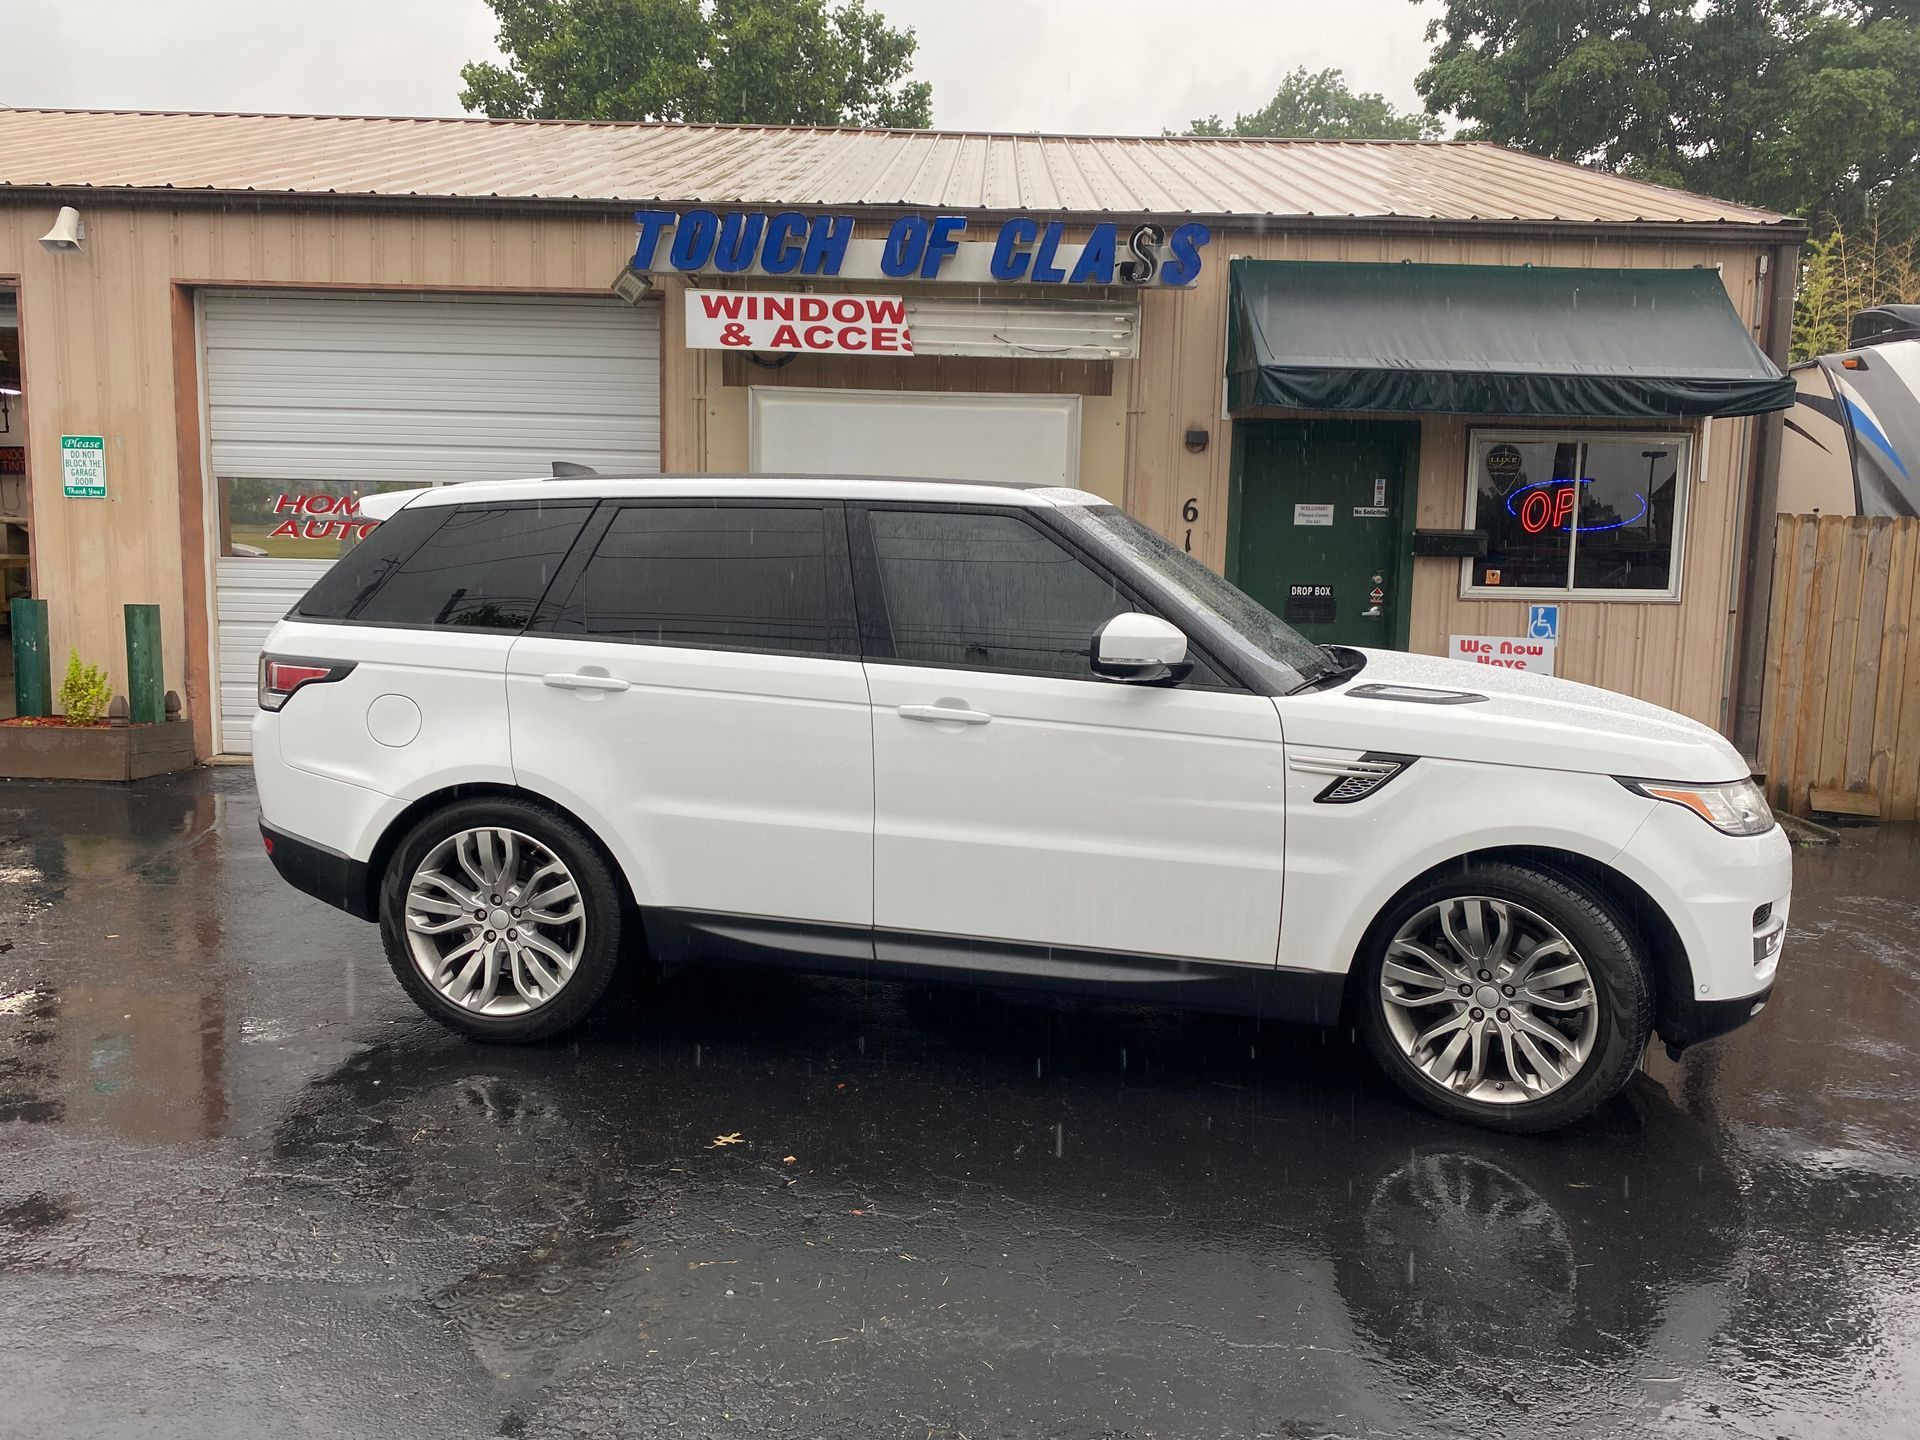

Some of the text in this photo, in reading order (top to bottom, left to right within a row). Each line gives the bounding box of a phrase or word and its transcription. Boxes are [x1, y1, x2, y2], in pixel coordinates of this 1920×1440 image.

[633, 208, 1211, 286] TOUCH OF CLASS
[719, 322, 753, 347] &
[65, 438, 100, 448] Please
[71, 450, 95, 459] DO NOT
[65, 459, 102, 468] BLOCK THE
[1490, 456, 1518, 465] LUXE
[71, 468, 97, 477] GARAGE
[75, 477, 94, 486] DOOR
[66, 487, 87, 495] Thank
[1363, 508, 1389, 517] Soliciting
[1521, 487, 1575, 533] OP
[1291, 585, 1331, 596] DROP BOX
[1460, 639, 1544, 656] We Now
